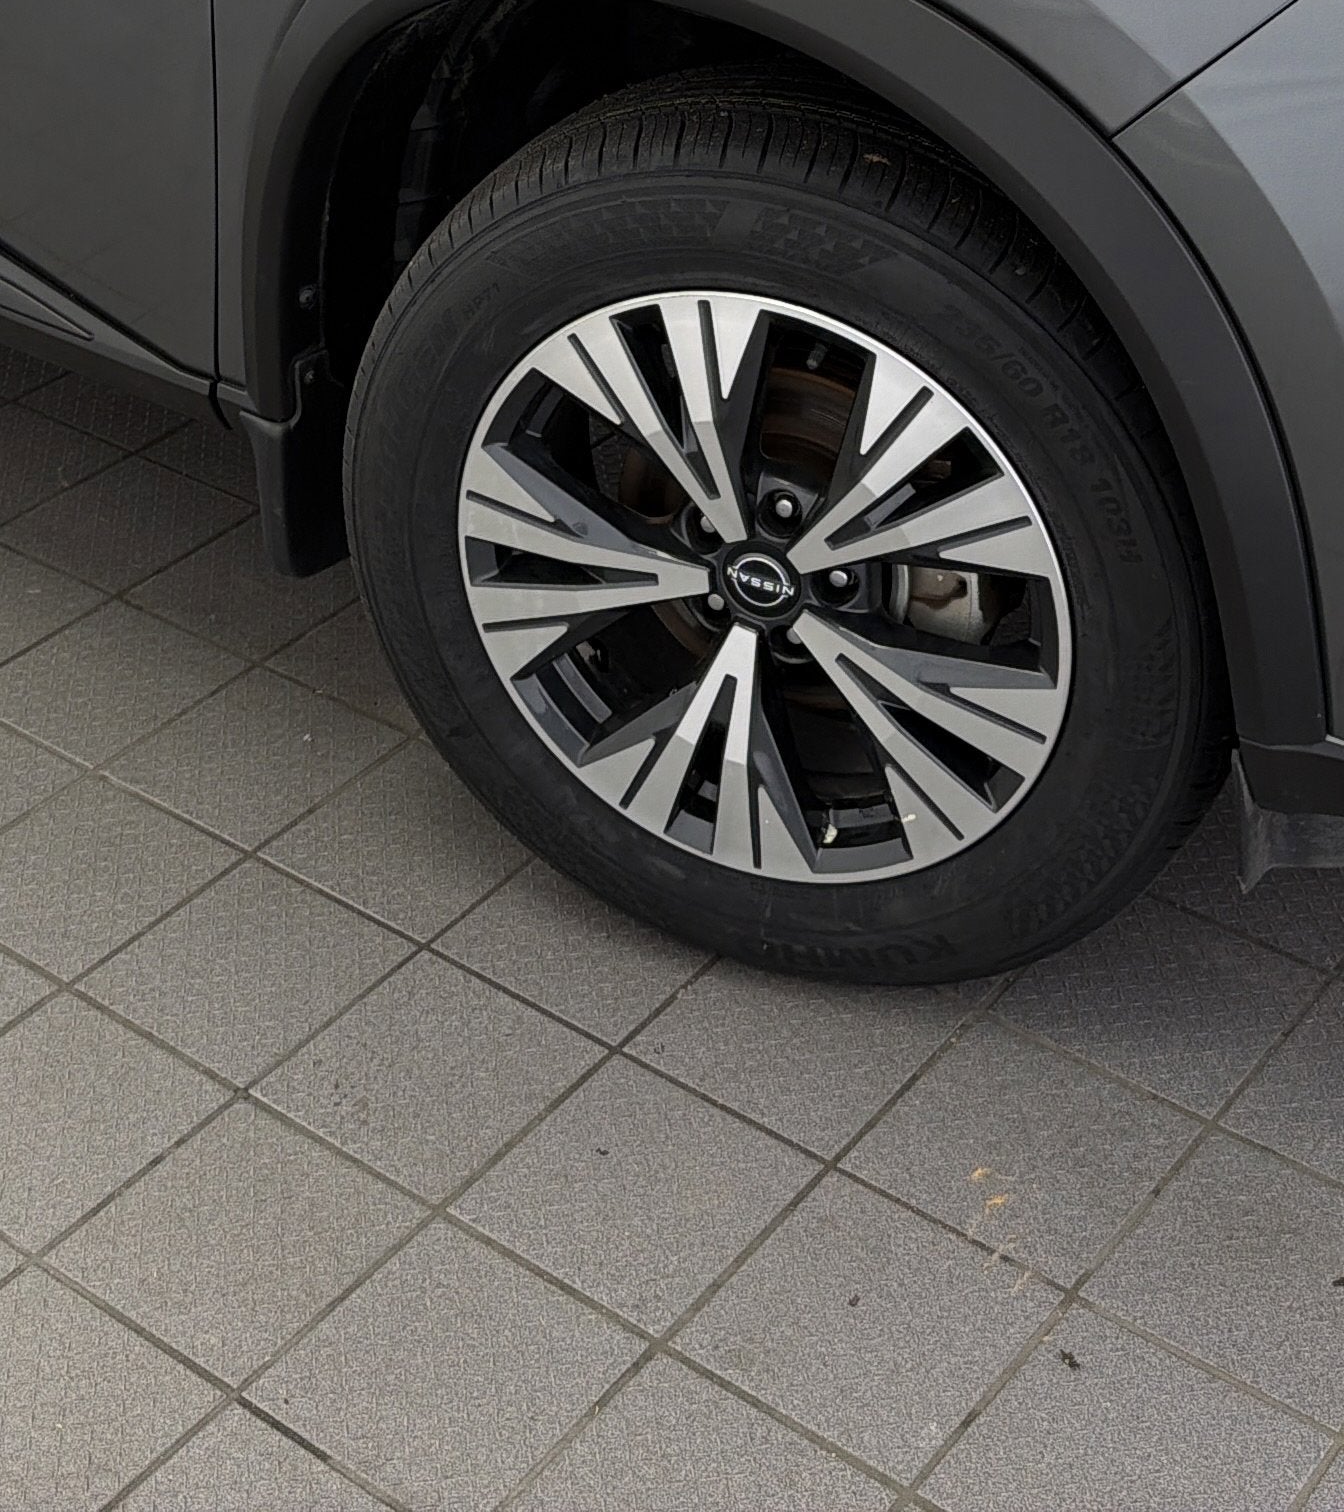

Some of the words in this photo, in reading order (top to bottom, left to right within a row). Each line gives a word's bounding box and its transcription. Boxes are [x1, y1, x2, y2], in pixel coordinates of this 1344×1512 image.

[1040, 402, 1096, 466] R18
[1090, 477, 1144, 564] 103H
[727, 566, 795, 596] NISSAN
